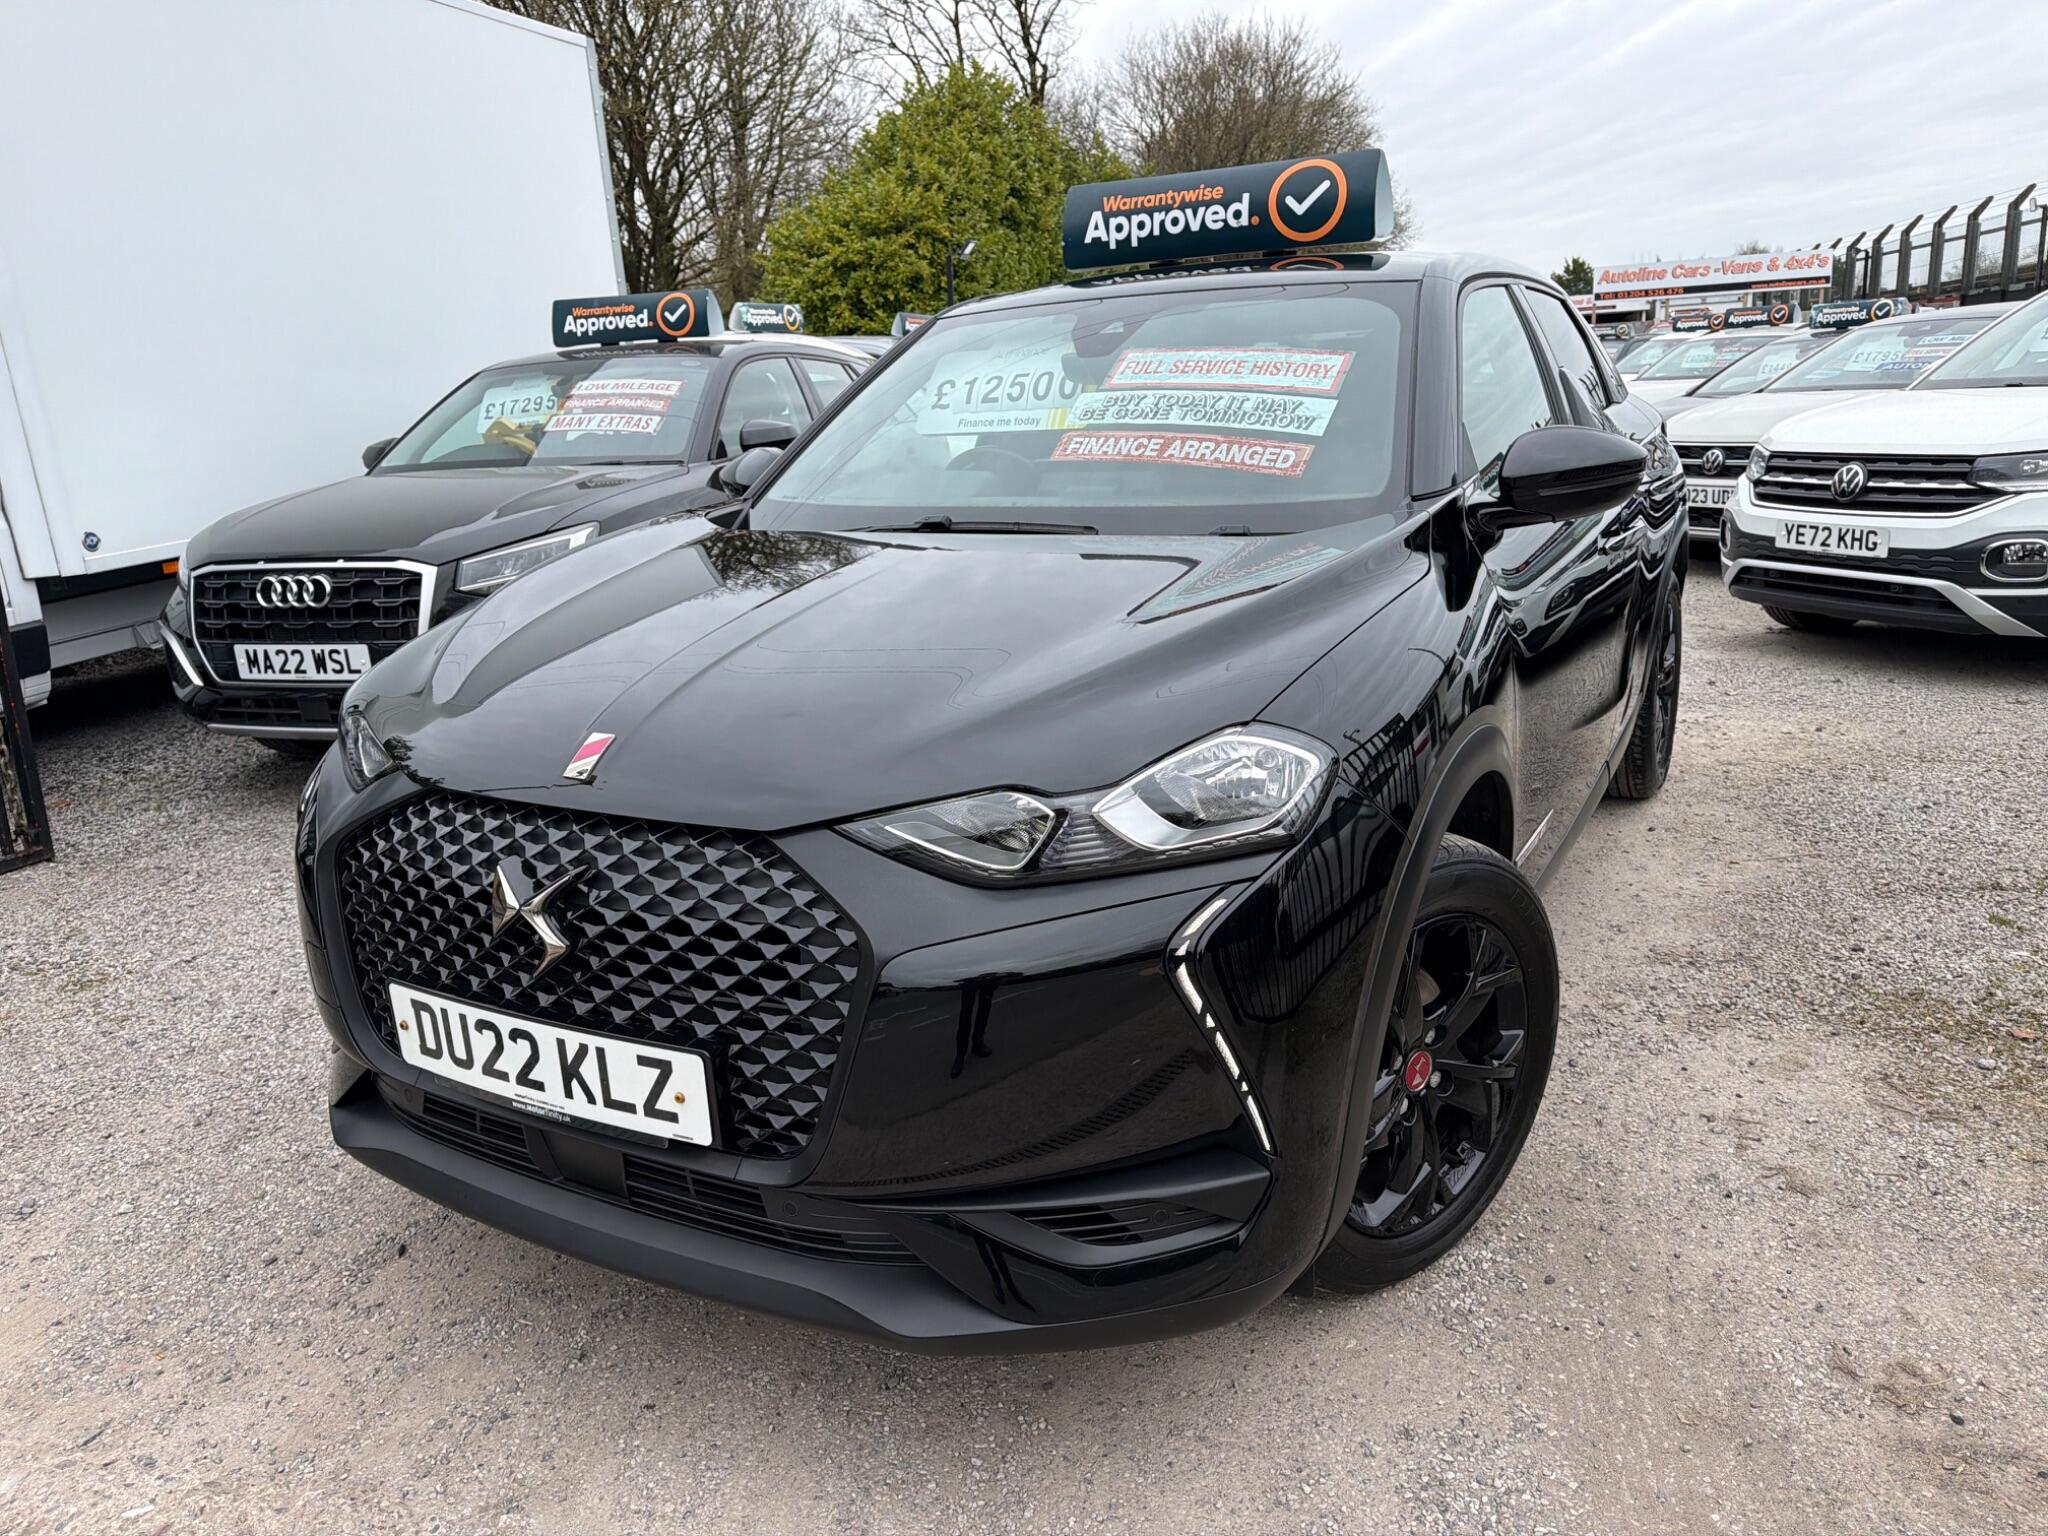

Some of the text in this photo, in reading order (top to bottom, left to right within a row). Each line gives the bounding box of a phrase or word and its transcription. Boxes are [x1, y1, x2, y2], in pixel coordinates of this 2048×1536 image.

[1102, 184, 1224, 213] Warrantywise
[1598, 266, 1668, 285] Autoline
[1672, 264, 1711, 280] Cars
[1767, 256, 1780, 272] &
[1784, 253, 1830, 271] 4x4's
[571, 303, 635, 318] Warrantywise
[1120, 359, 1336, 379] FULL SERVICE HISTORY
[577, 382, 677, 392] LOW MILEAGE
[931, 370, 1080, 410] £12500
[484, 394, 556, 420] £17295
[1102, 393, 1304, 415] BUY TODAY IT MAY
[553, 416, 653, 431] MANY EXTRAS
[958, 415, 1042, 429] Finance me today
[1079, 406, 1316, 431] BE GONE TOMMOROW
[1067, 437, 1296, 469] FINANCE ARRANGED
[1784, 522, 1880, 552] YE72 KHG
[244, 648, 362, 675] MA22 WSL
[410, 998, 680, 1125] DU22 KLZ
